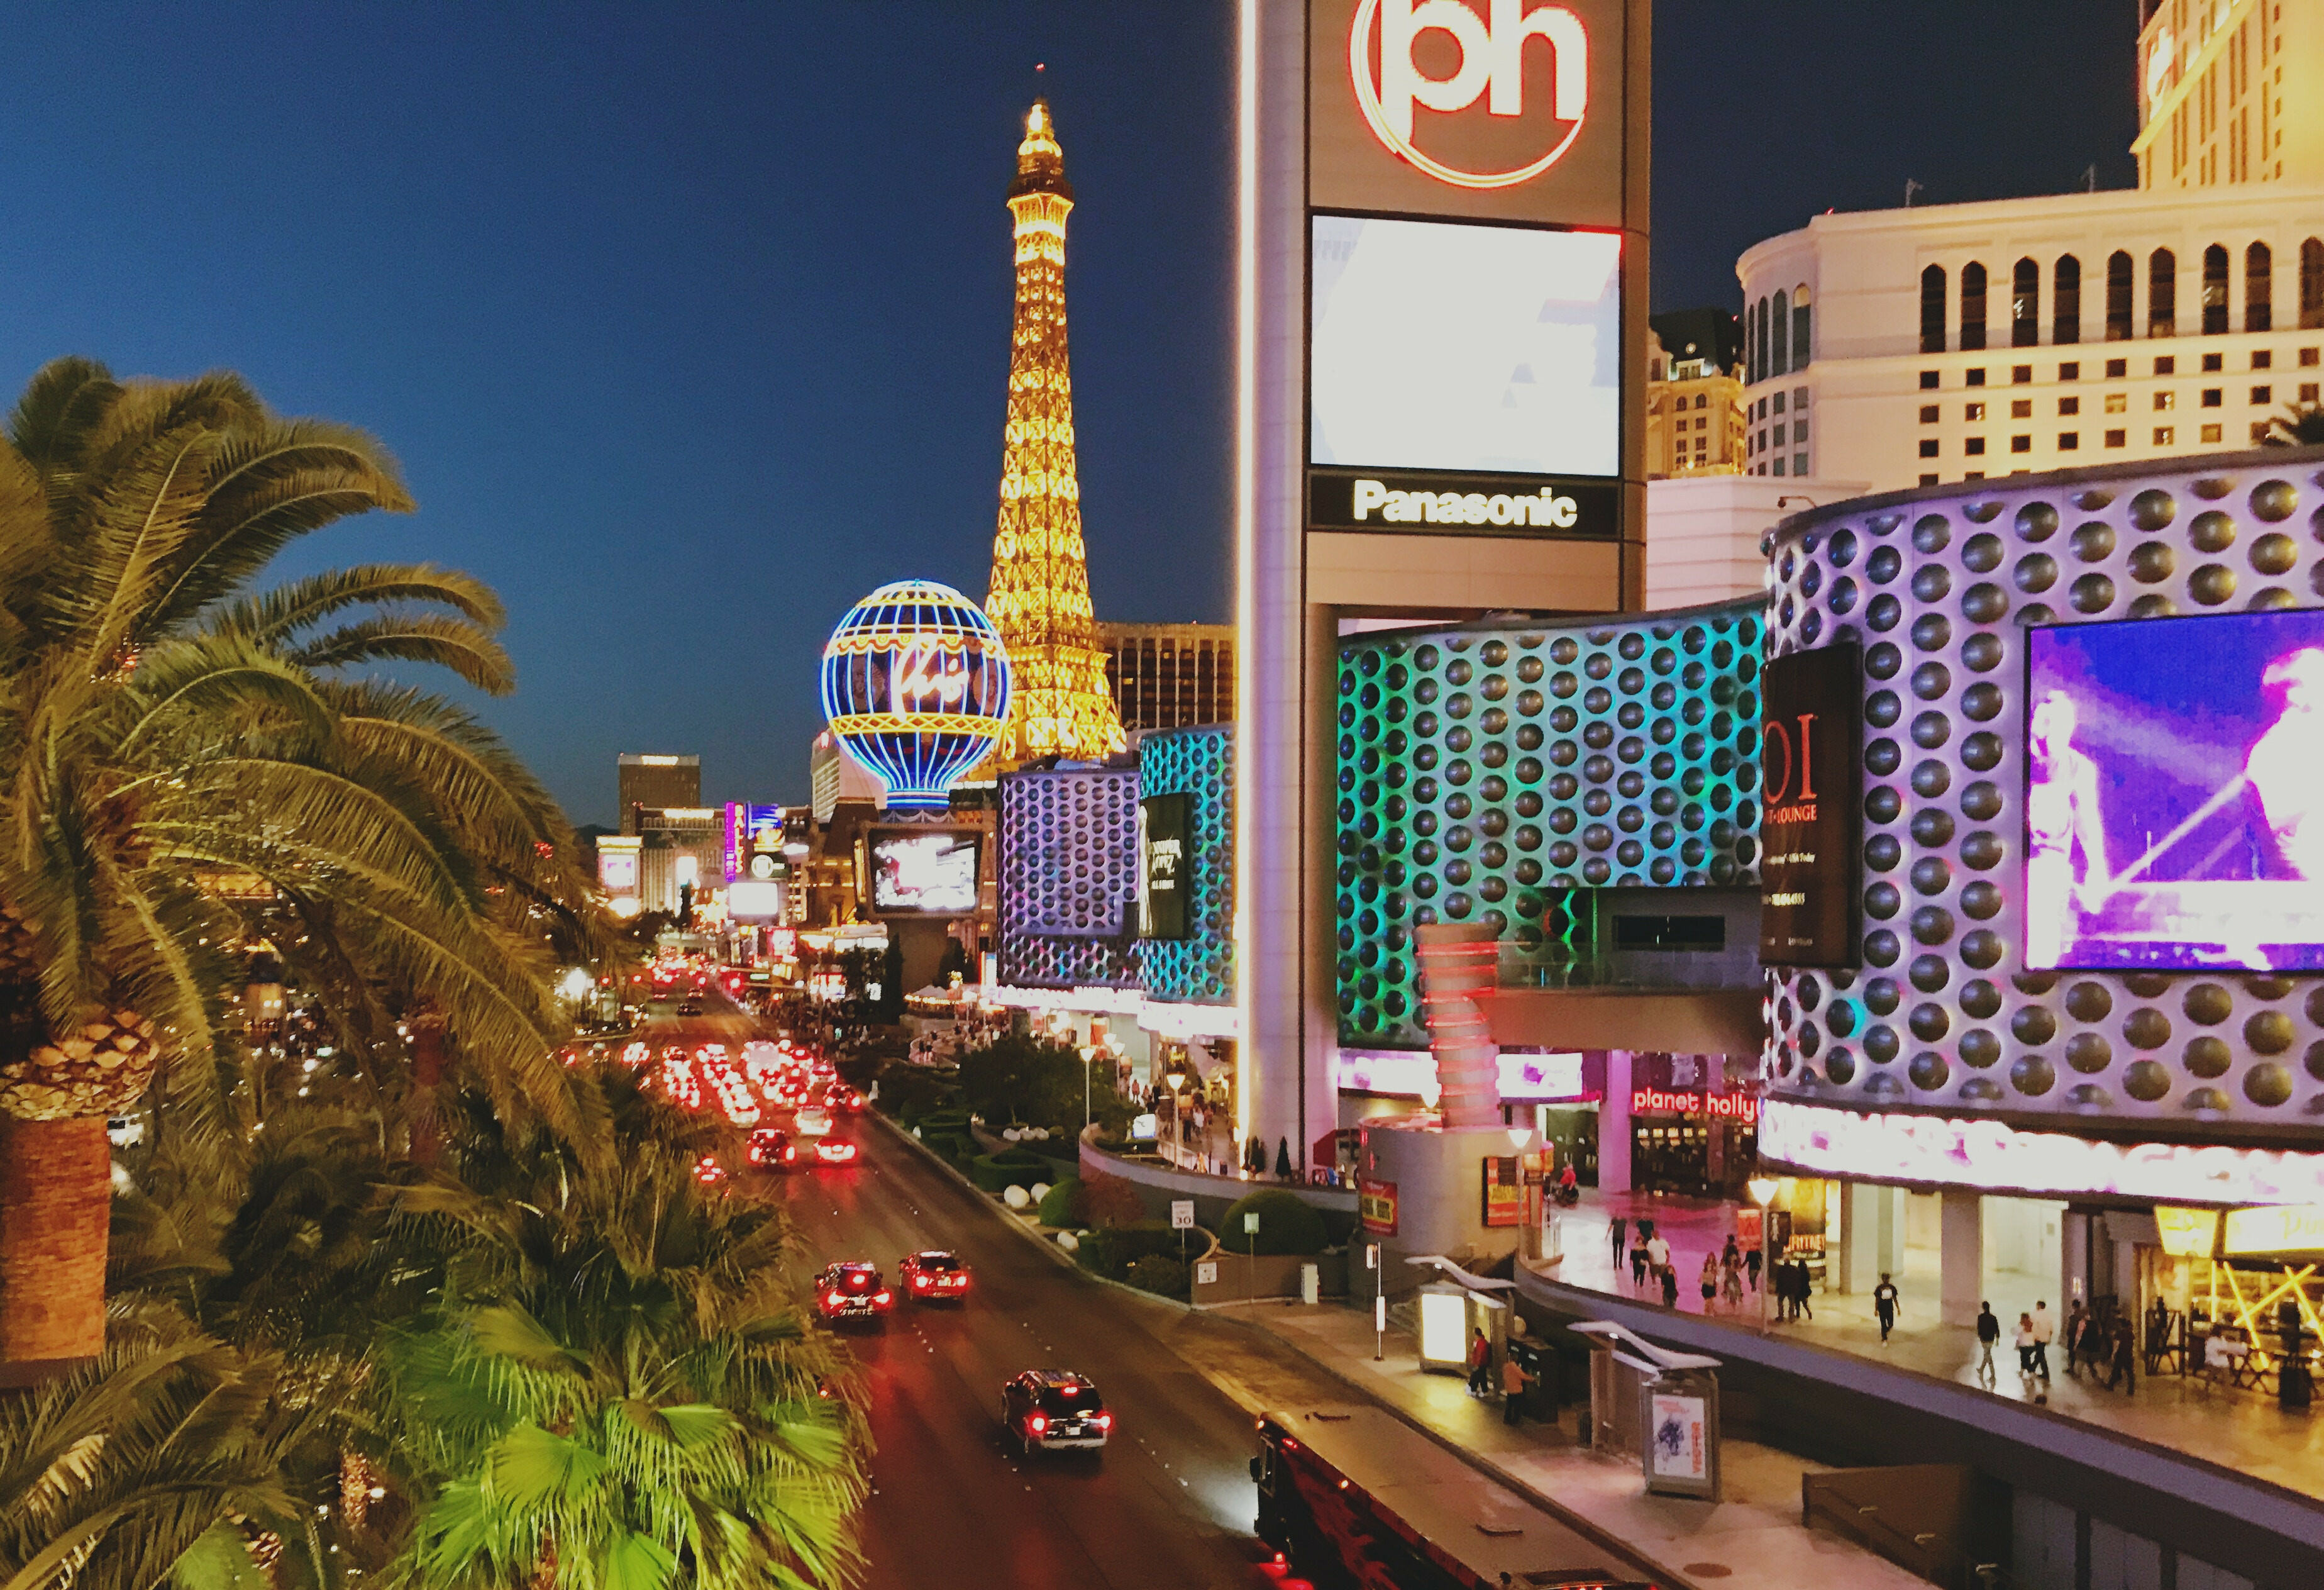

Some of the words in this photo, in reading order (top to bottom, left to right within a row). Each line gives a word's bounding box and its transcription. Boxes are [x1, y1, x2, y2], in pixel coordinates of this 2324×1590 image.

[1380, 0, 1588, 146] ph
[1353, 479, 1578, 528] Panasonic
[1633, 1086, 1699, 1112] planet
[1706, 1091, 1760, 1123] holly
[1175, 1215, 1192, 1226] 30
